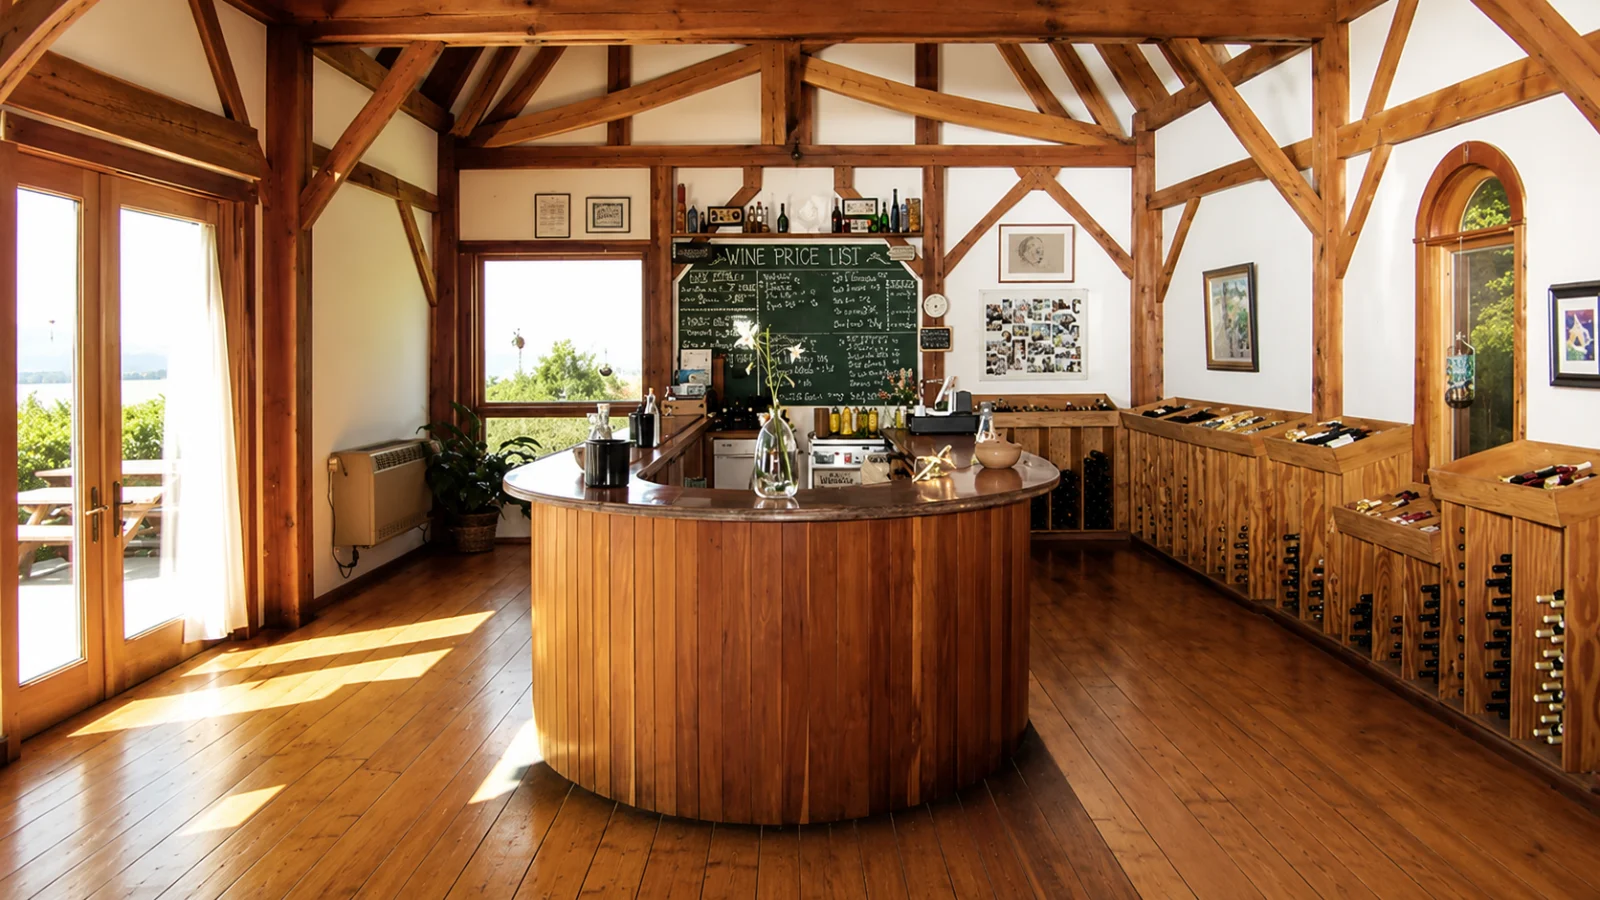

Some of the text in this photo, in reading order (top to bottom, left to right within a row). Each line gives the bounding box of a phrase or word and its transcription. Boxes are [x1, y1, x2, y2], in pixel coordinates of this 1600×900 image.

[725, 247, 766, 266] WINE
[774, 247, 820, 266] PRICE
[829, 247, 862, 266] LIST
